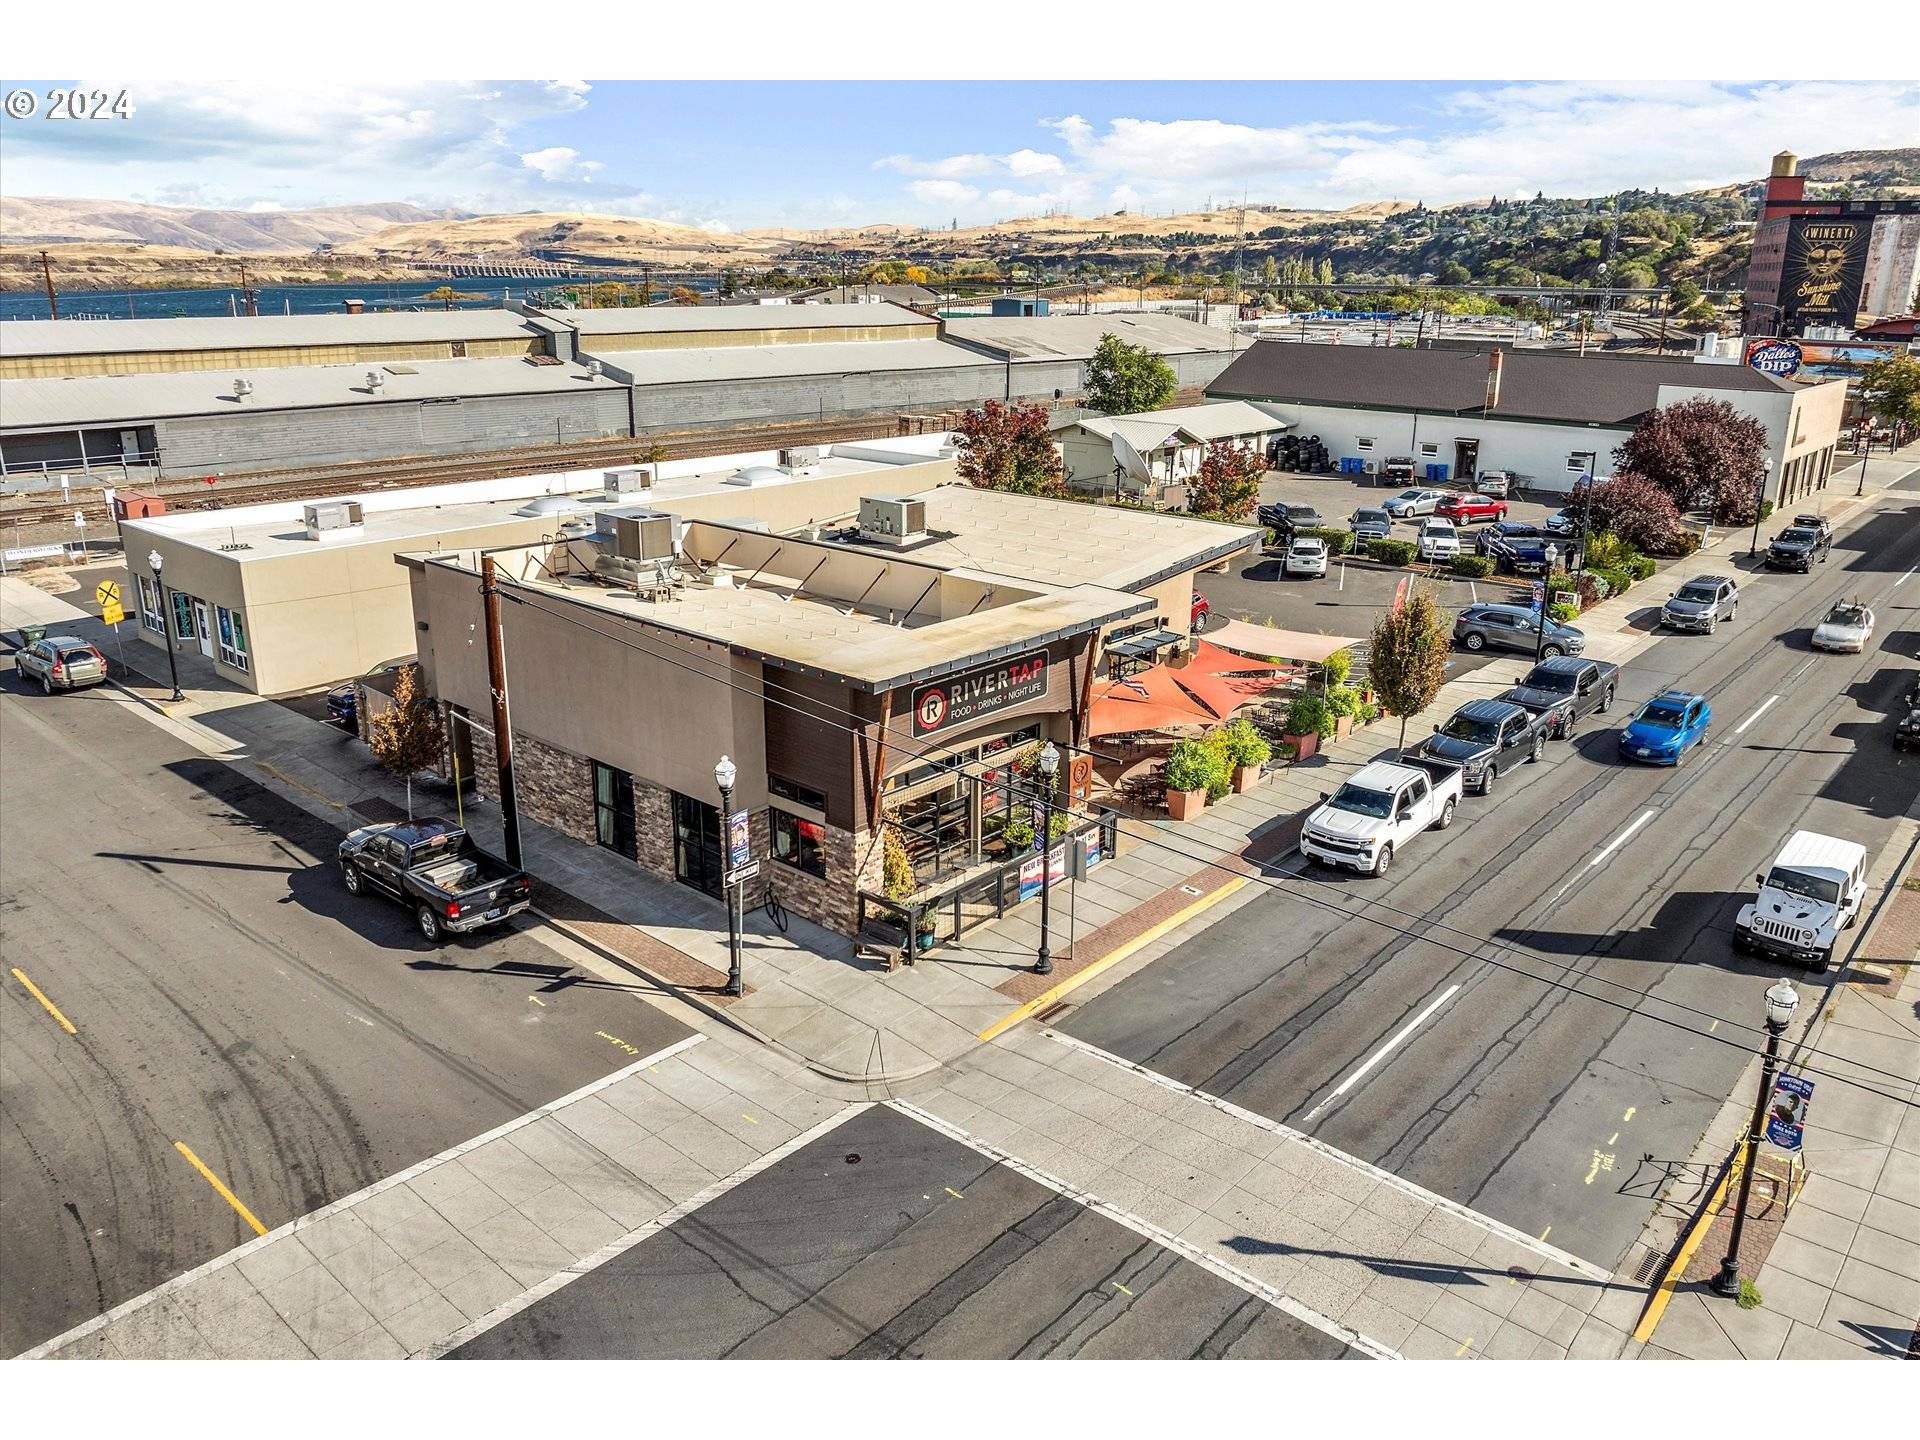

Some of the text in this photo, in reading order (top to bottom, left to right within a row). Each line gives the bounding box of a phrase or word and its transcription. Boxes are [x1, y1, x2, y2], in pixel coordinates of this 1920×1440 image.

[1810, 226, 1851, 239] WINERY
[1797, 280, 1842, 297] Sunshine
[1805, 292, 1831, 306] Mill
[1755, 347, 1797, 361] Dalles
[1760, 360, 1793, 372] DIP
[951, 681, 1042, 719] FOOD DRINKS NIGHT LIFE
[1023, 859, 1036, 873] NEW
